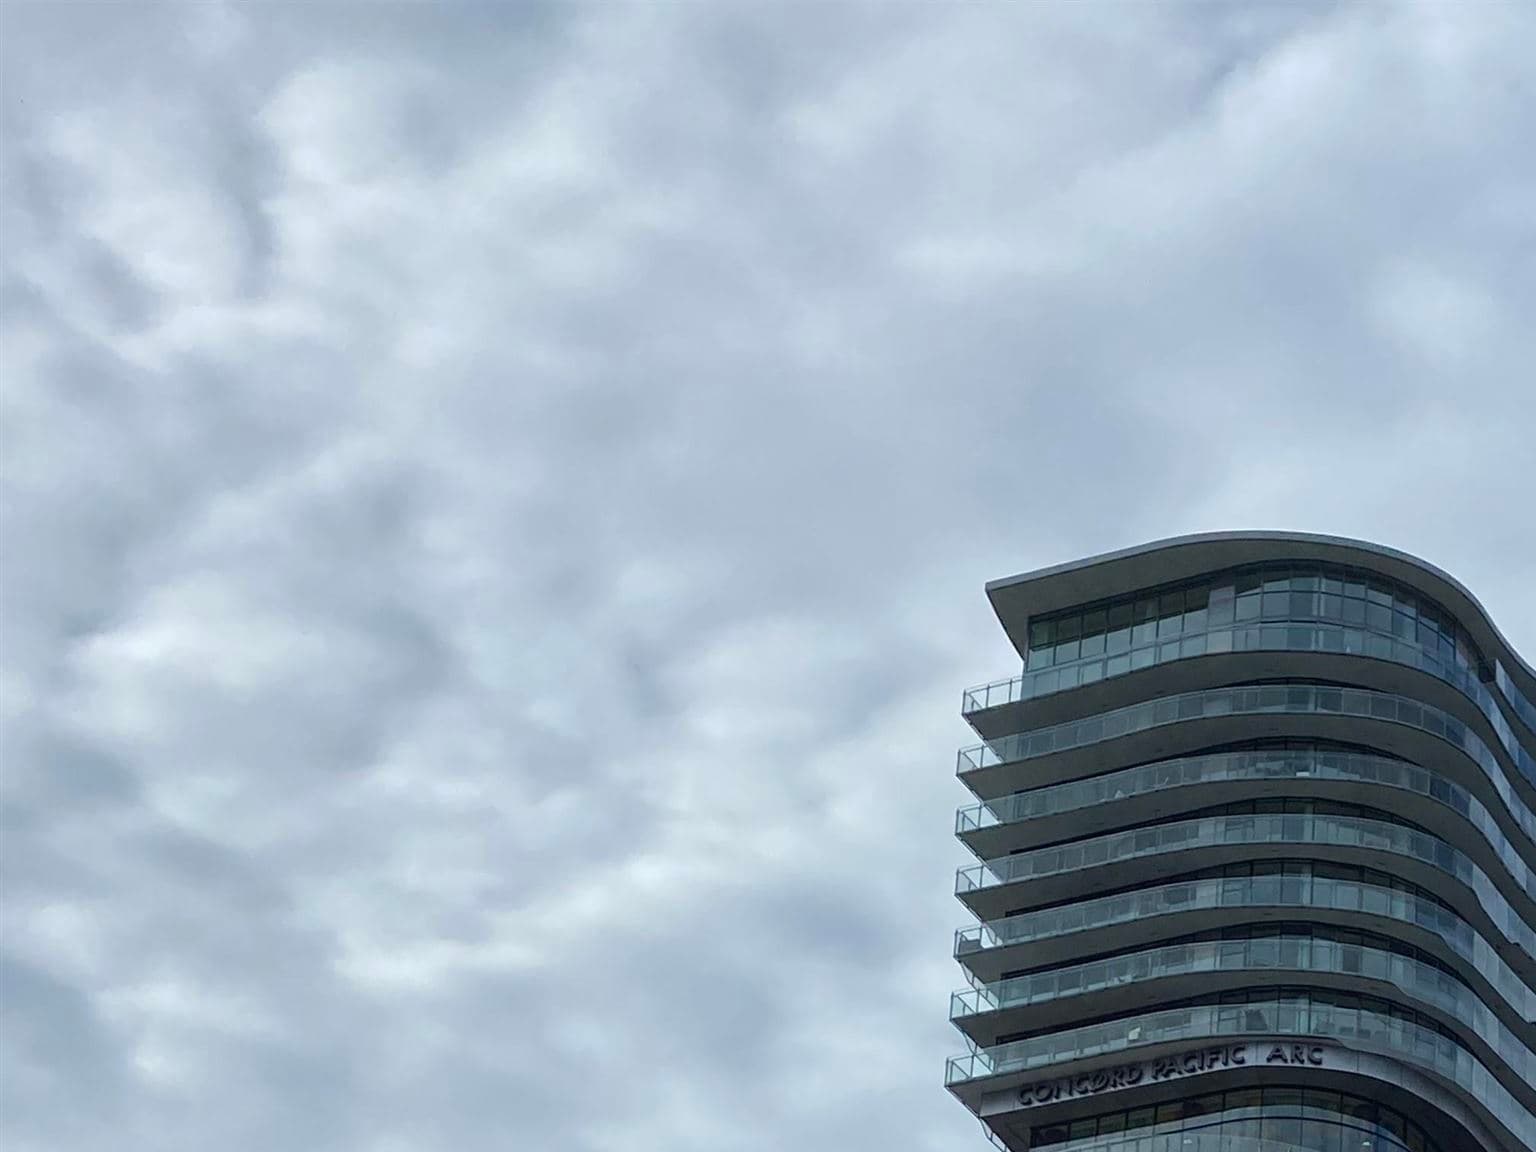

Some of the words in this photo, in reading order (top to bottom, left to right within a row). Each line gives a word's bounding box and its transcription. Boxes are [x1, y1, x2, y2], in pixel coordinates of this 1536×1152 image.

[1018, 1067, 1143, 1106] CONCORD
[1151, 1046, 1246, 1080] PACIFIC
[1266, 1045, 1325, 1065] ARC
